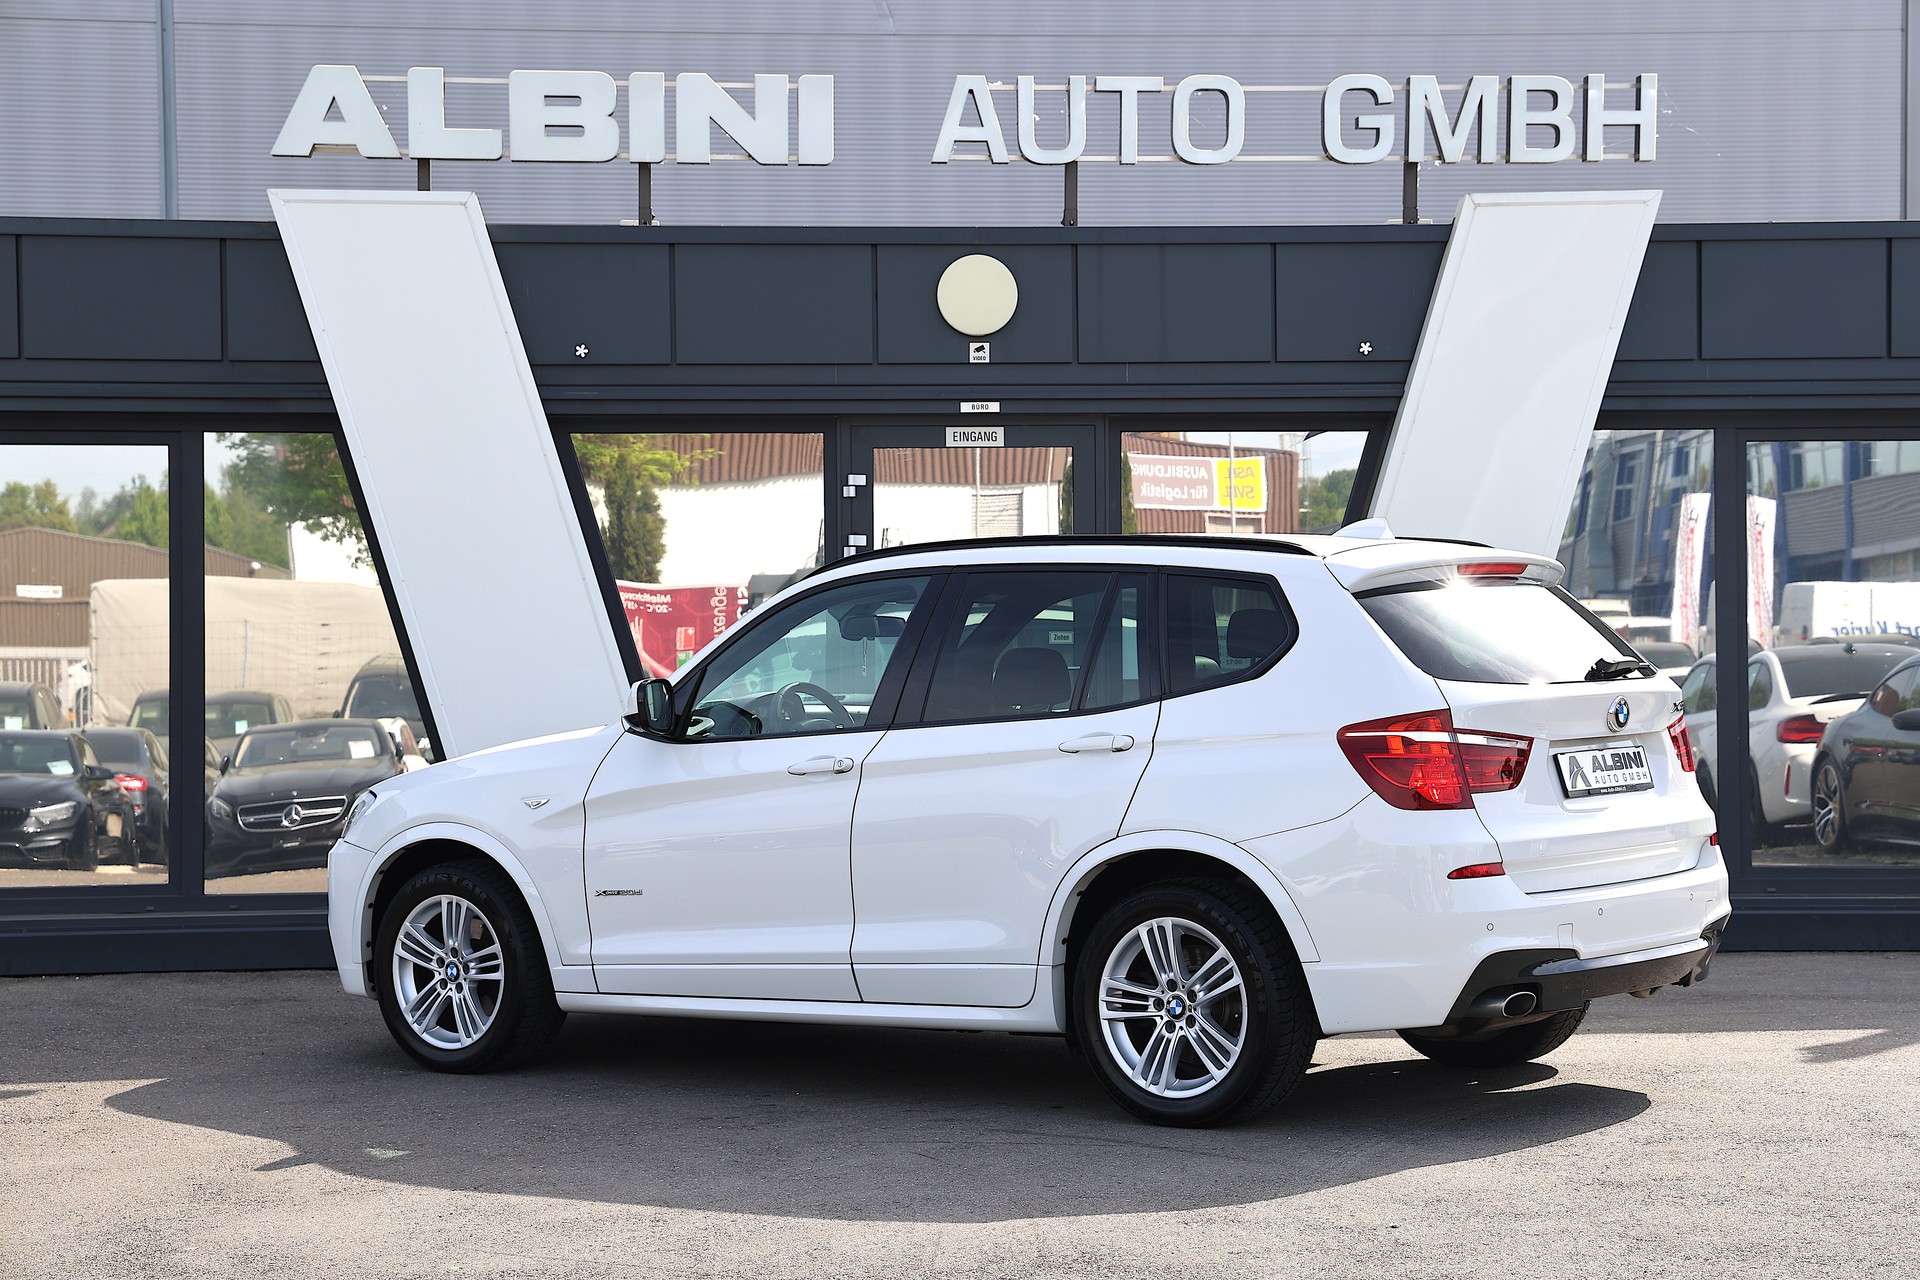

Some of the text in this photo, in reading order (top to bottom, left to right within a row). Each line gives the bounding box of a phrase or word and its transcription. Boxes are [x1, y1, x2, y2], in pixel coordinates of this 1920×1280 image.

[270, 64, 1659, 166] ALBINI AUTO GMBH
[953, 431, 998, 442] EINGANG
[1592, 751, 1645, 773] ALBINI
[1594, 771, 1648, 785] AUTO GMBH
